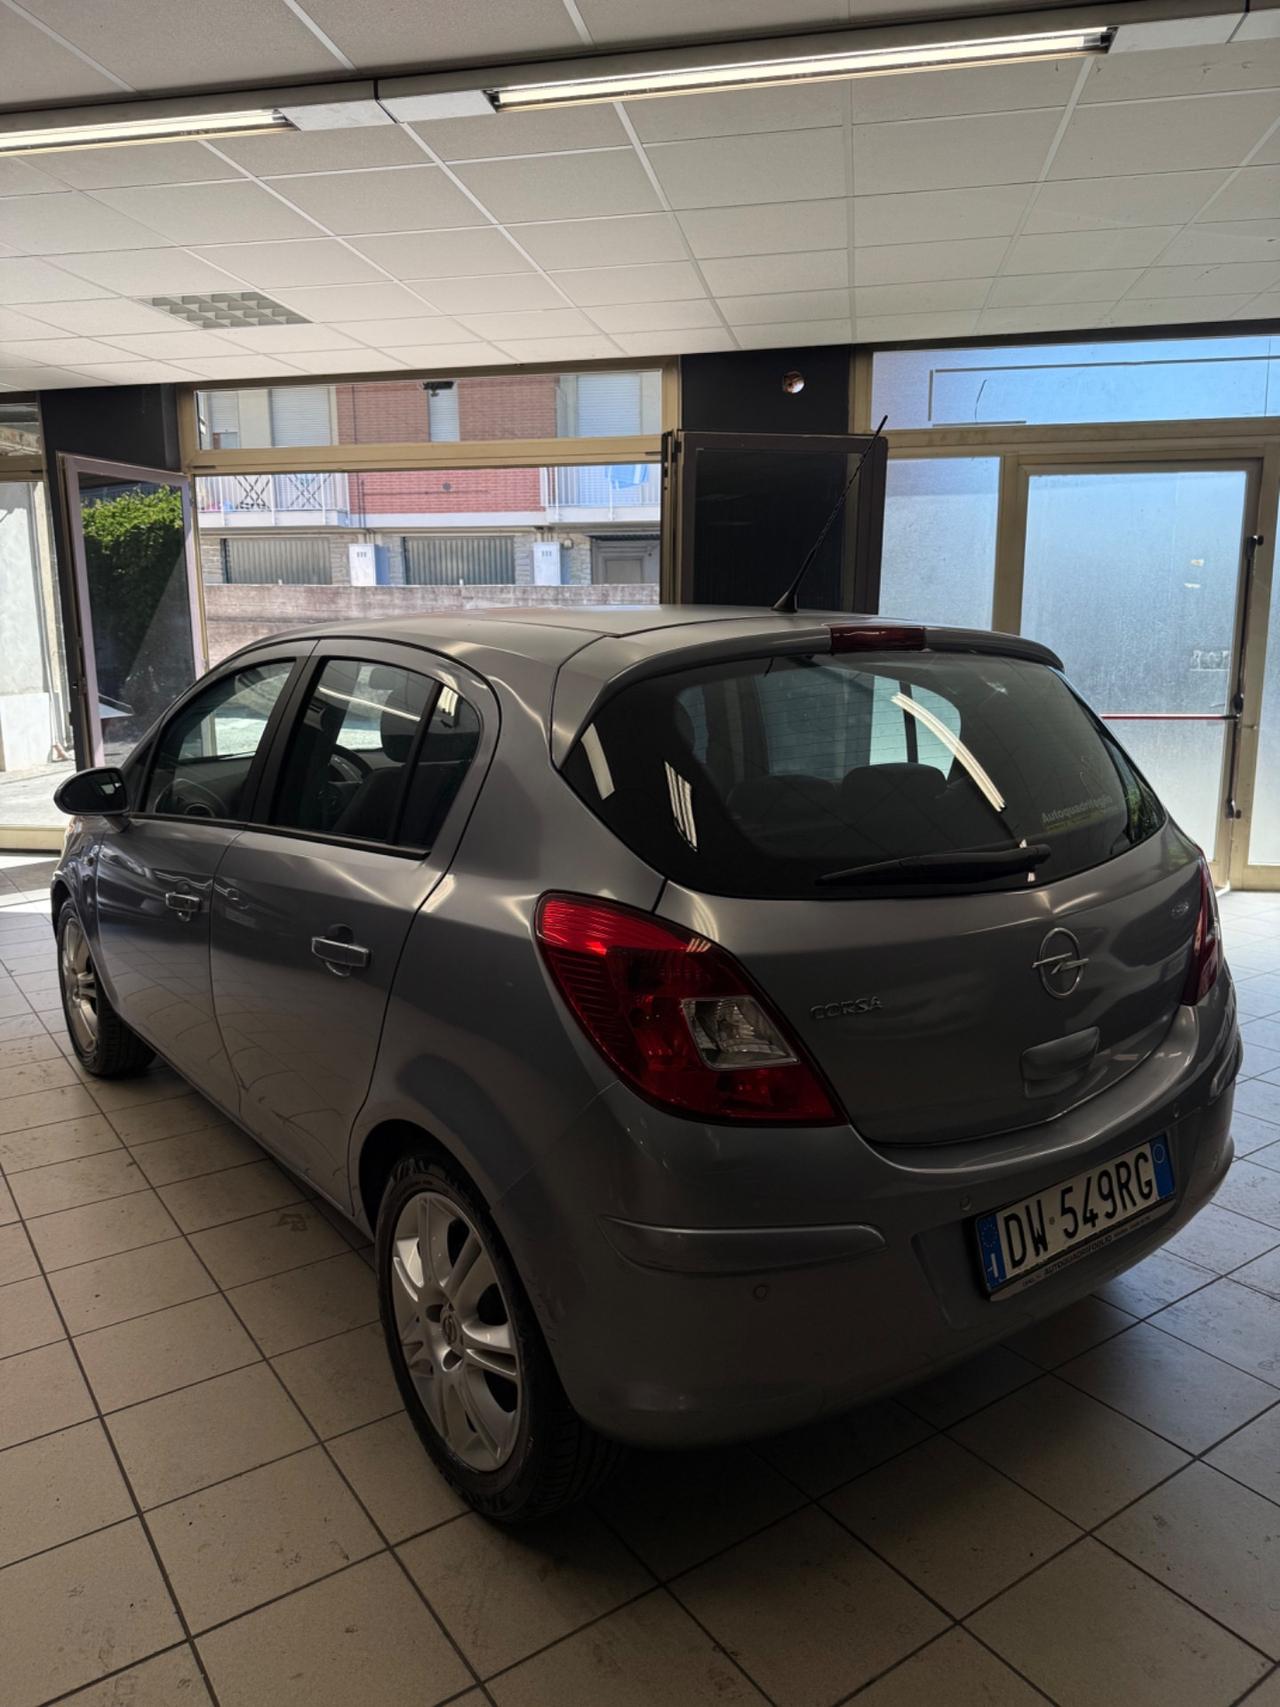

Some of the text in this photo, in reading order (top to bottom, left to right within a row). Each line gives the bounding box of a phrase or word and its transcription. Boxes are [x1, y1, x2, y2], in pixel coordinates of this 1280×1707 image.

[809, 996, 883, 1018] CORSA
[1003, 1151, 1154, 1269] DW 549RG
